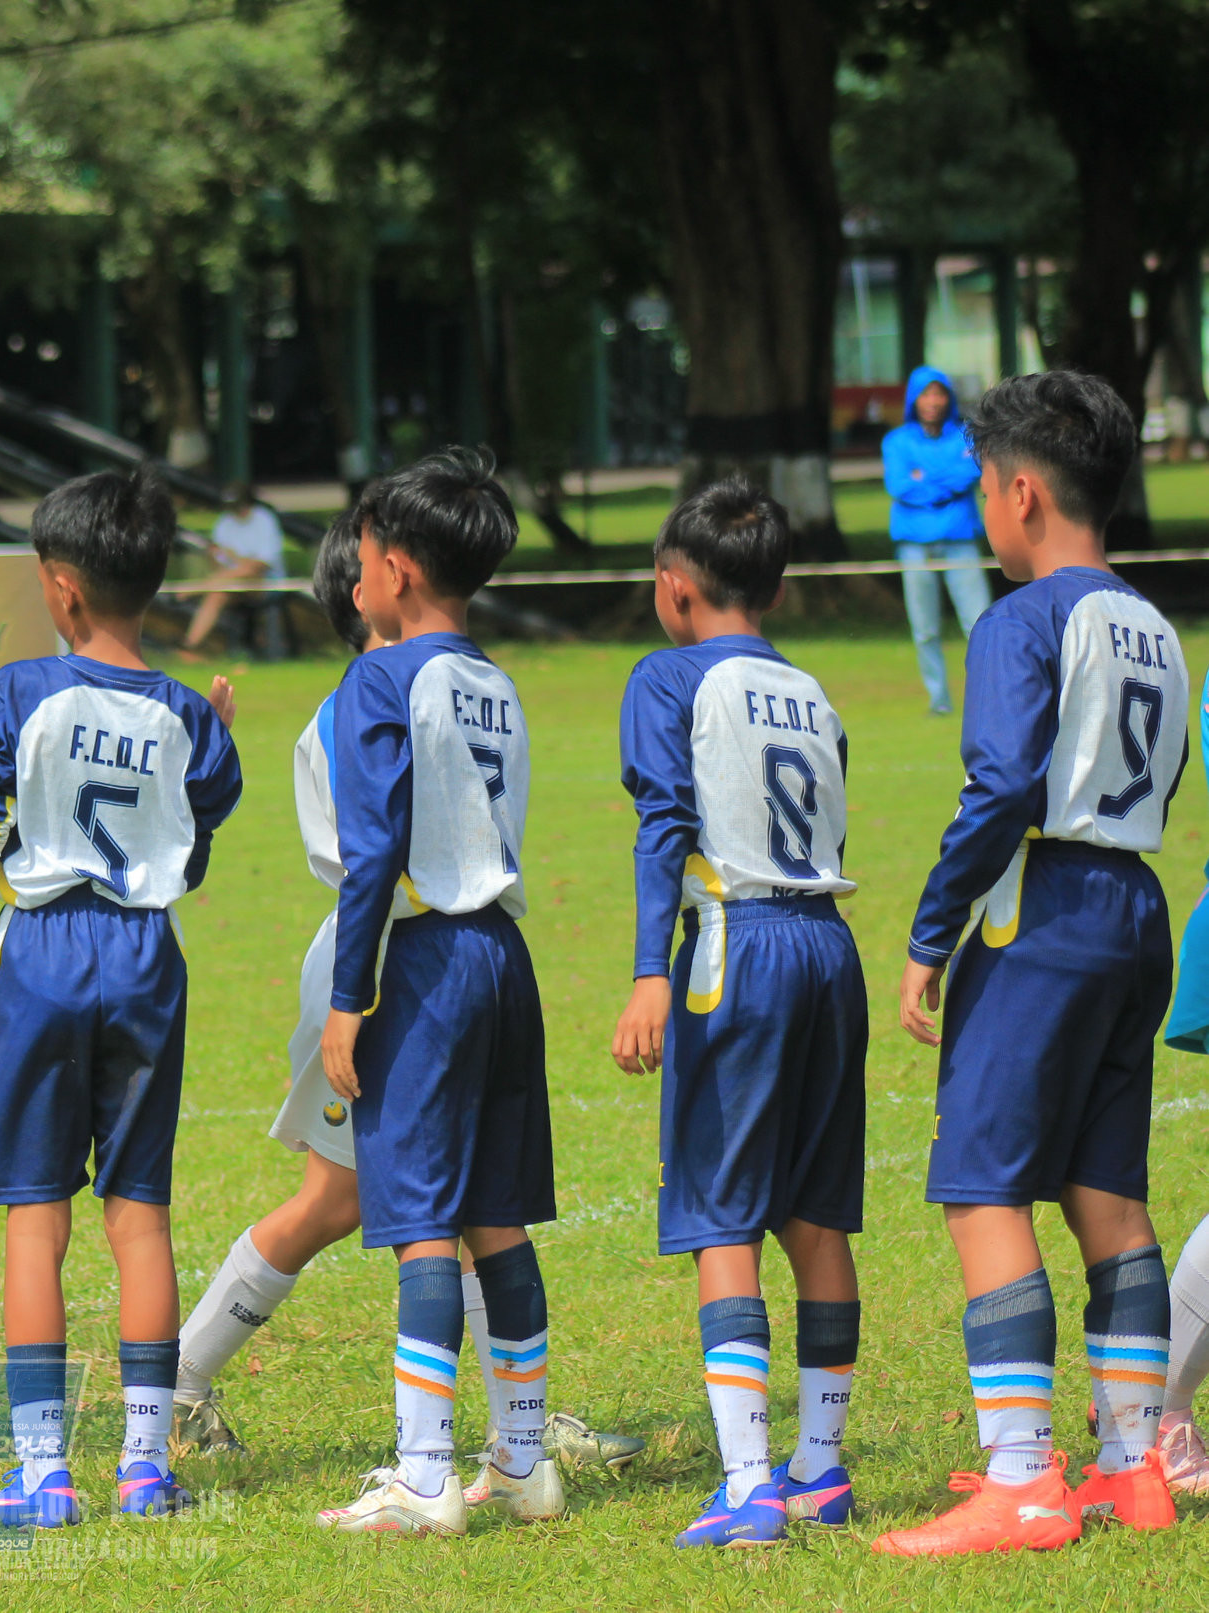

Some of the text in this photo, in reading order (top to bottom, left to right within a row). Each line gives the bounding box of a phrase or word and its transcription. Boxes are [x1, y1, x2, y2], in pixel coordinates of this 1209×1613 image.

[70, 725, 158, 775] F.C.D.C
[745, 690, 819, 736] F.C.D.C
[1097, 677, 1163, 820] 9
[72, 780, 139, 900] 5
